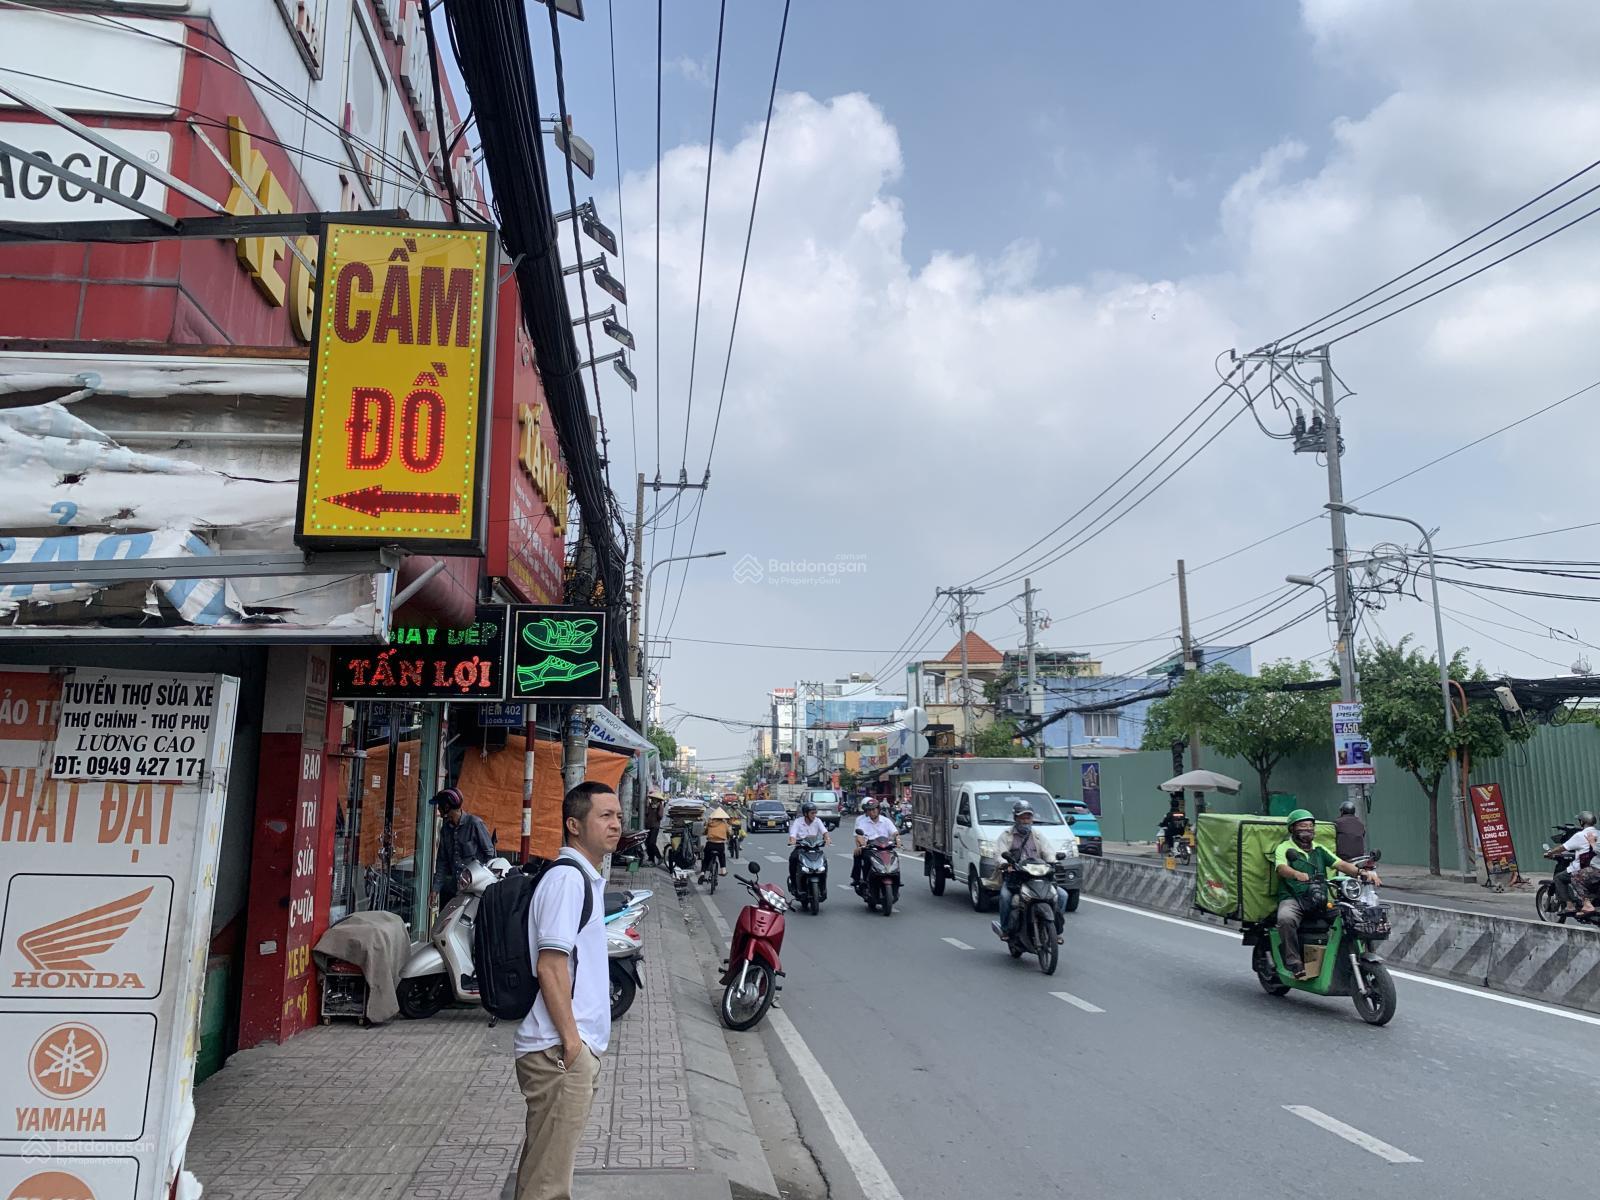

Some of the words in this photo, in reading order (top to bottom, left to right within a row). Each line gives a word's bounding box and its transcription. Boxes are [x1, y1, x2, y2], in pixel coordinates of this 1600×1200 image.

[333, 238, 474, 347] CẦM
[345, 361, 448, 473] ĐỒ
[349, 648, 425, 687] TẤN
[432, 655, 492, 693] LỢI
[64, 674, 117, 706] TUYỂN
[122, 683, 153, 711] THỢ
[156, 678, 189, 707] SỬA
[193, 686, 214, 707] XE
[64, 712, 91, 731] THỢ
[94, 709, 137, 729] CHÍNH
[152, 713, 179, 733] THỢ
[181, 715, 210, 734] PHỤ
[505, 706, 521, 716] 402
[75, 733, 148, 753] LƯƠNG
[153, 736, 195, 753] CAO
[54, 755, 82, 775] ĐT:
[86, 756, 131, 776] 0949
[135, 757, 170, 776] 427
[175, 757, 206, 777] 171
[296, 836, 314, 877] SỬA
[11, 972, 145, 988] HONDA
[16, 1107, 107, 1132] YAMAHA
